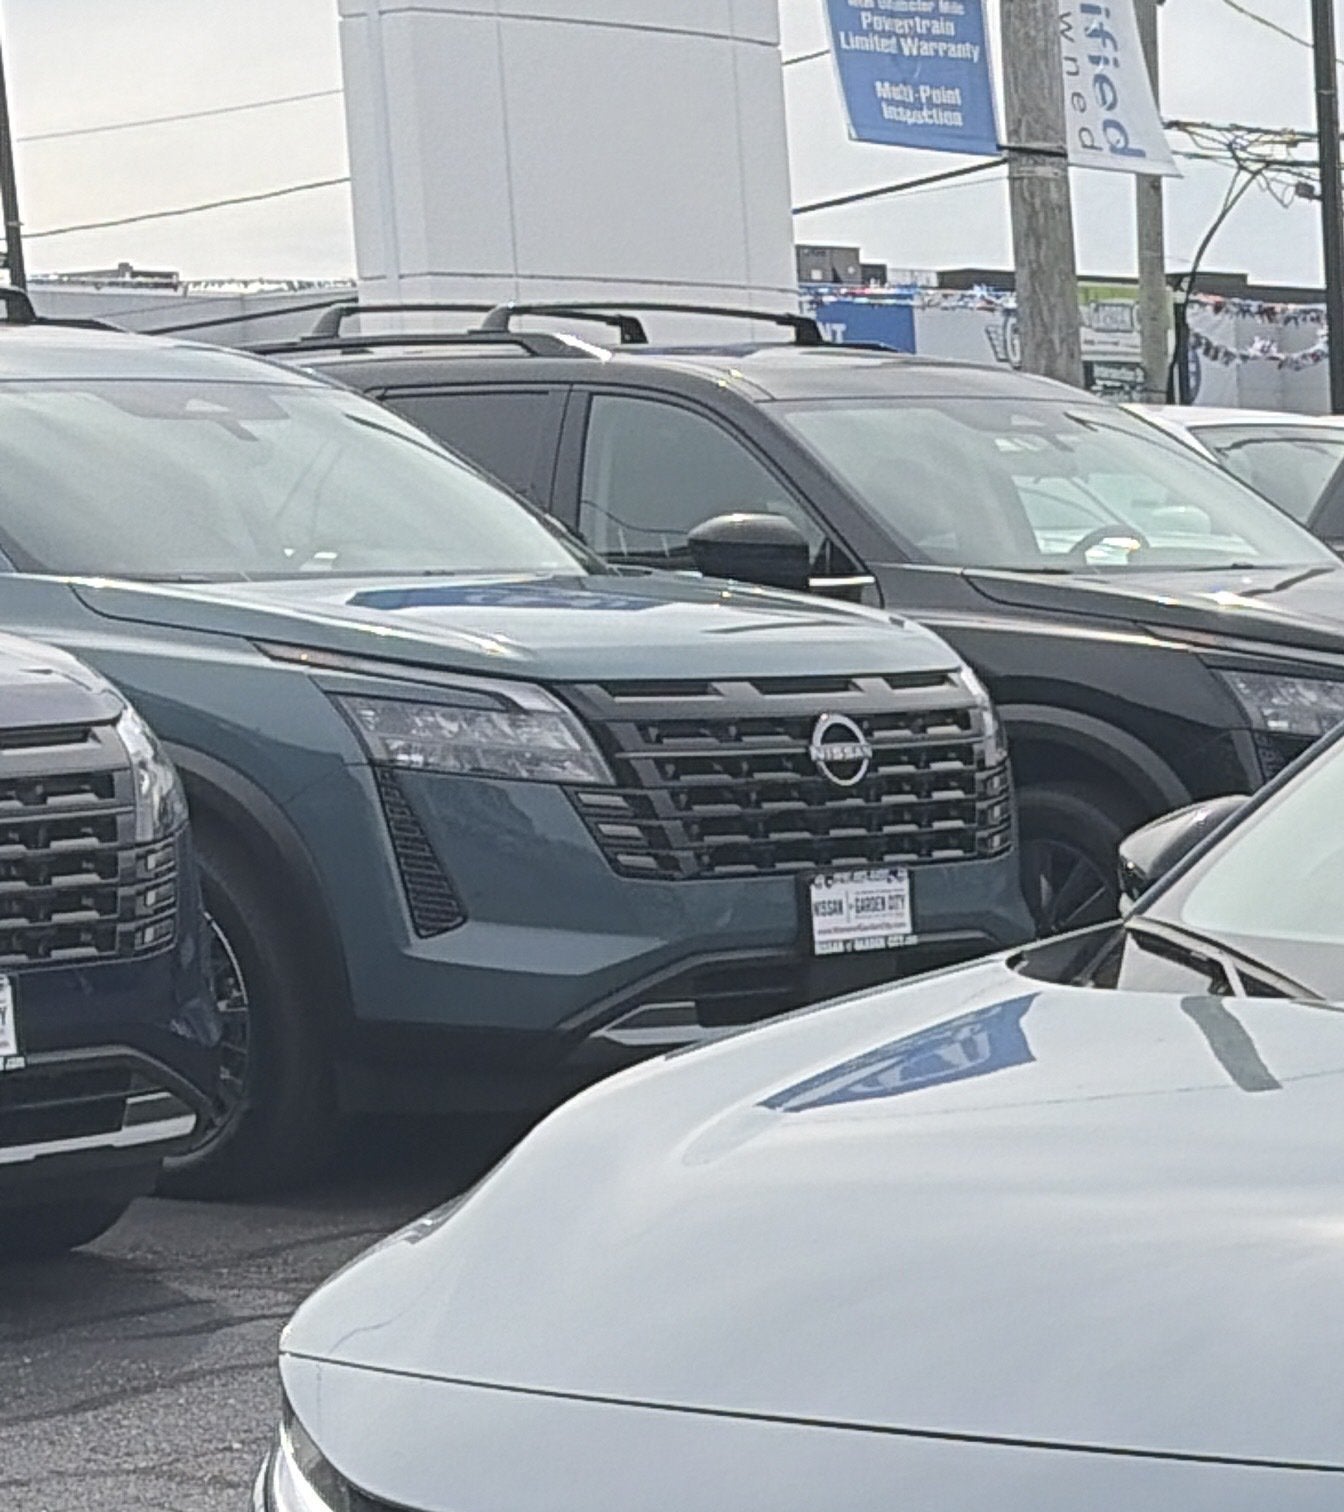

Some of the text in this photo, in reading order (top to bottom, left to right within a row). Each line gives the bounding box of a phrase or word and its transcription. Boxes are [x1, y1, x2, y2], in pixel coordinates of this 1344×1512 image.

[860, 12, 956, 36] Powertrain
[839, 31, 981, 63] Limited Warranty
